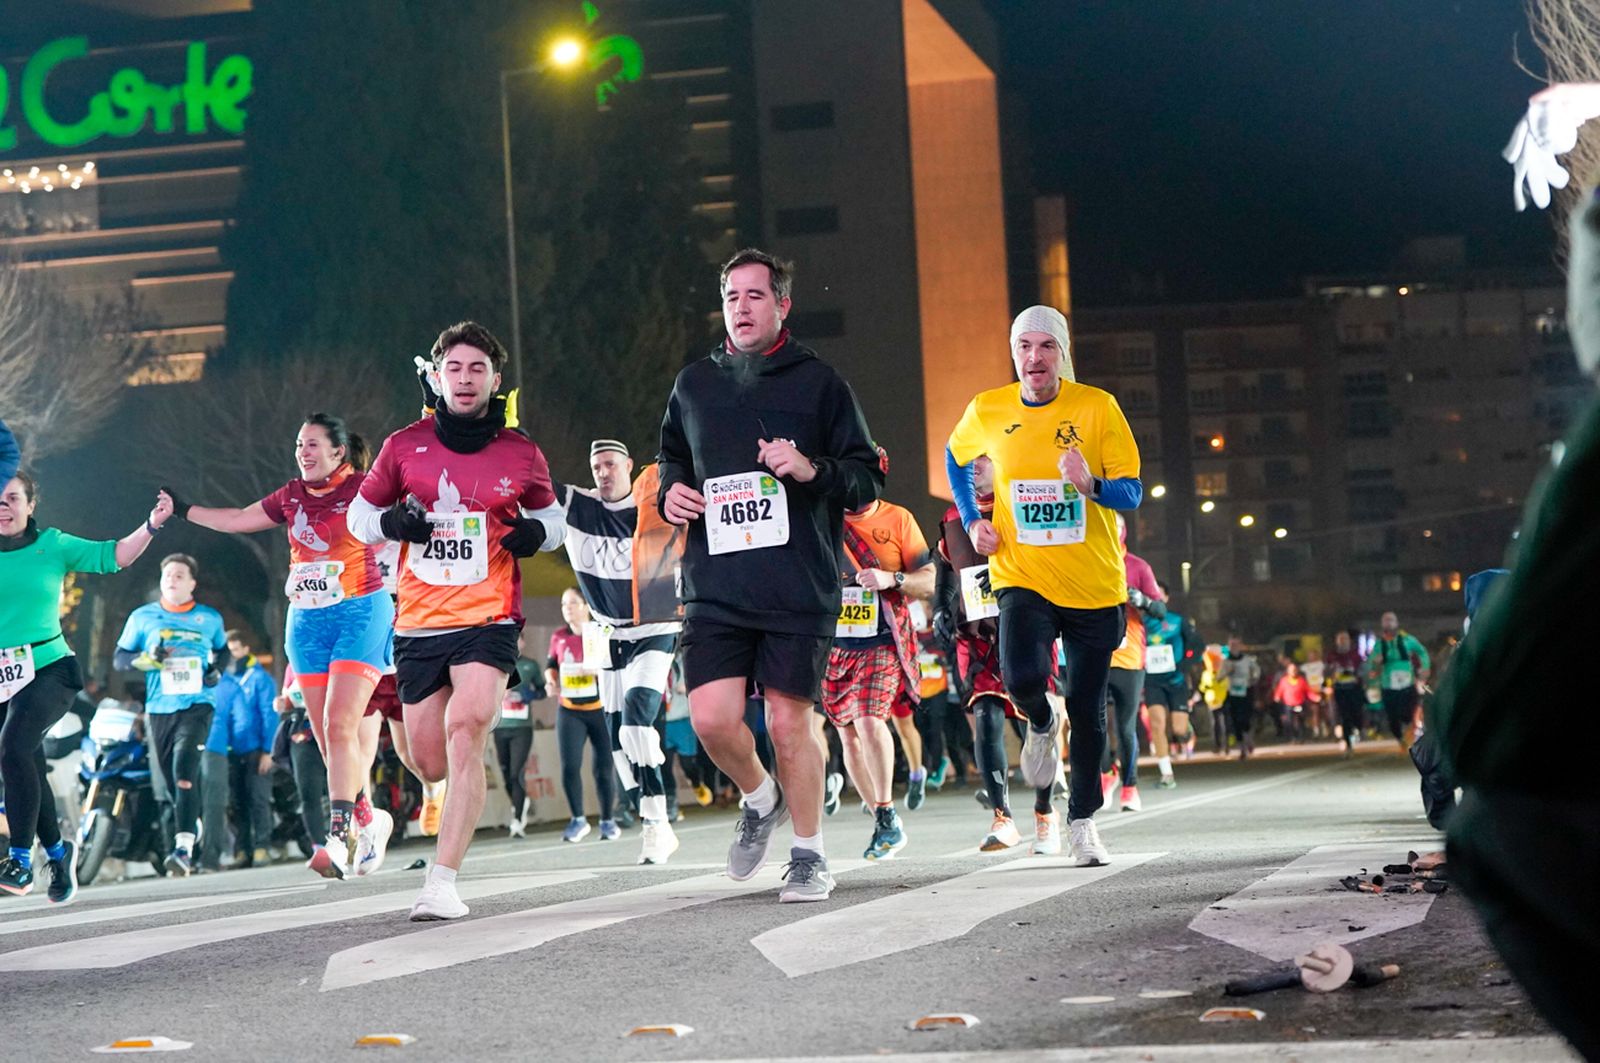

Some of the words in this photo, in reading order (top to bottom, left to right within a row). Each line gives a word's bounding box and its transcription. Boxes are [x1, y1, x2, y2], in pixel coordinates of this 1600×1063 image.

[21, 35, 254, 147] Corte
[720, 482, 743, 492] NOCHE
[744, 481, 753, 490] DE
[1048, 486, 1056, 494] DE
[713, 494, 728, 504] SAN
[720, 498, 773, 526] 4682
[1021, 501, 1075, 523] 12921
[300, 530, 315, 545] 43
[422, 539, 473, 560] 2936
[172, 671, 190, 681] 190
